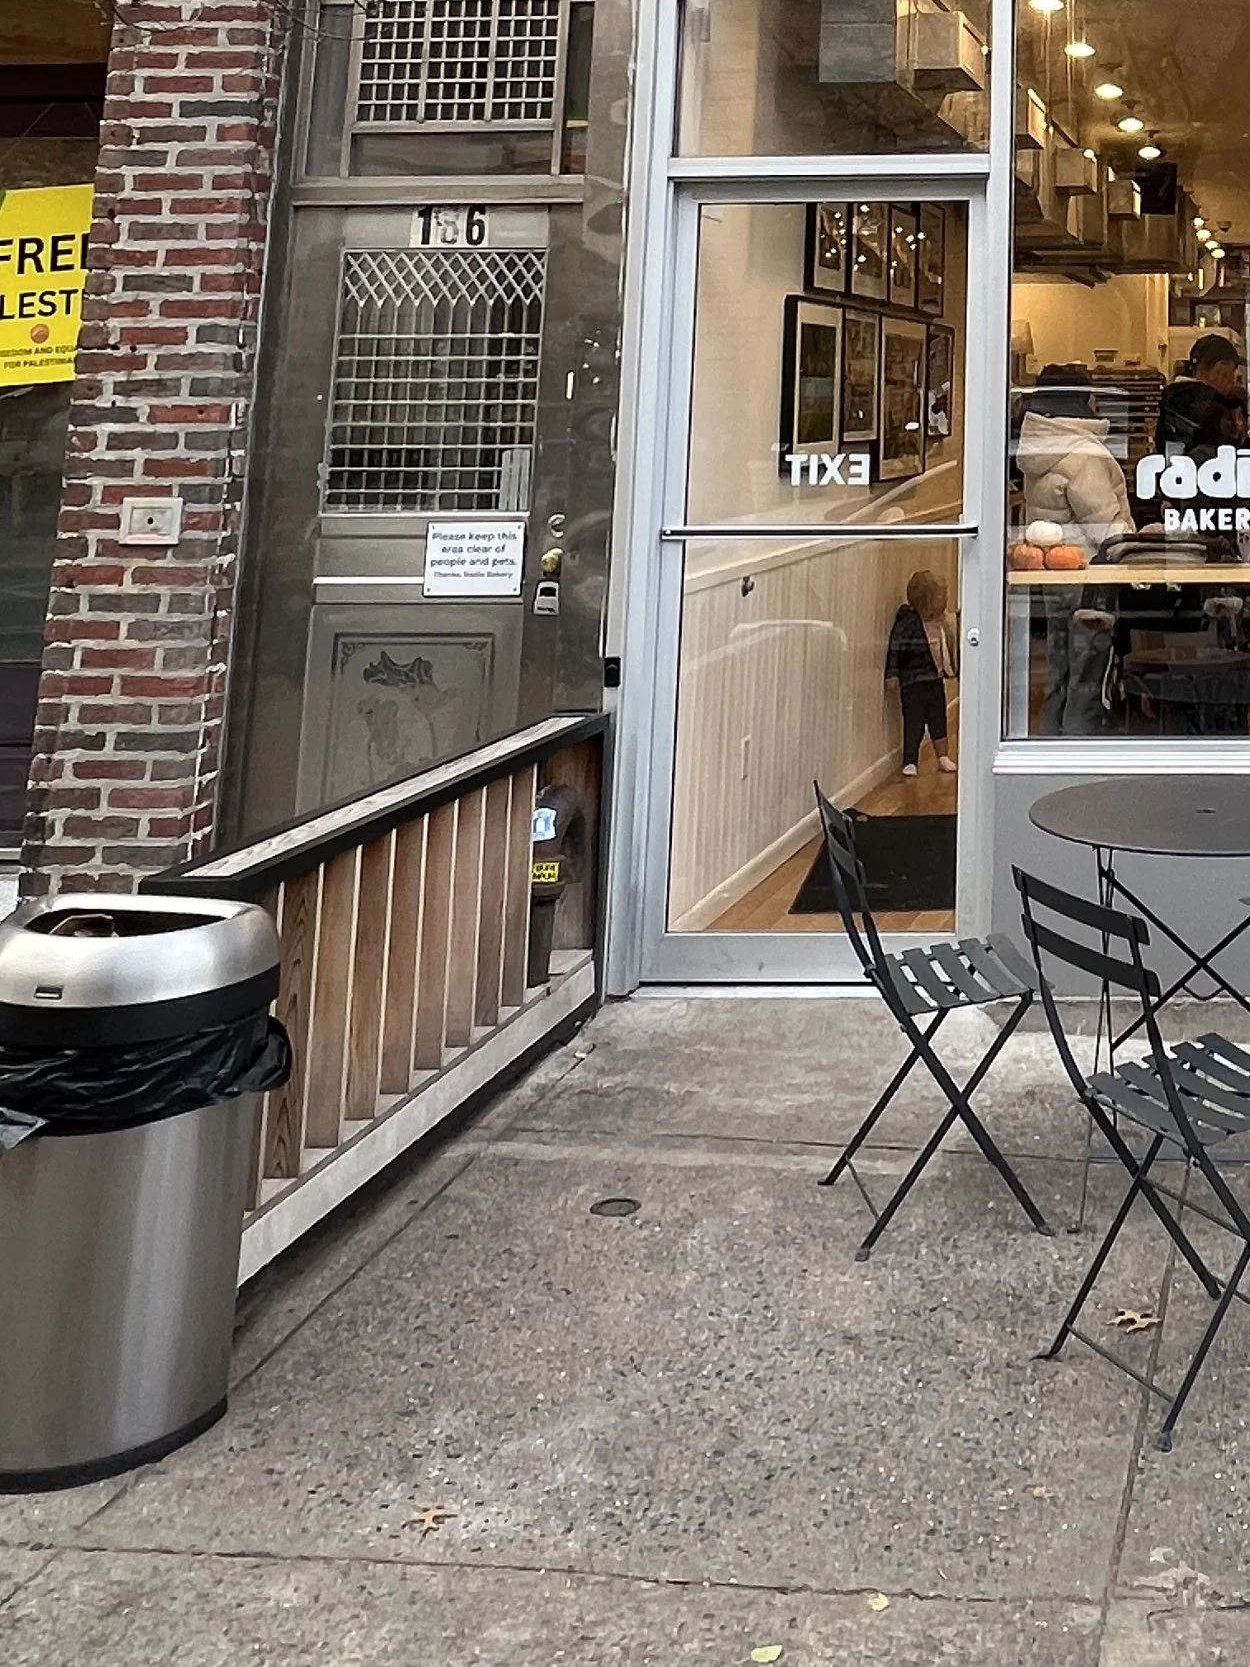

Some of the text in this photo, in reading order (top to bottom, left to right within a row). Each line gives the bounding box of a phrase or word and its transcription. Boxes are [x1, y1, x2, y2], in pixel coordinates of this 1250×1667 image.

[0, 288, 85, 320] LEST
[432, 531, 518, 542] Please keep this
[441, 543, 506, 553] area clear of
[430, 557, 467, 568] people
[468, 557, 489, 566] and
